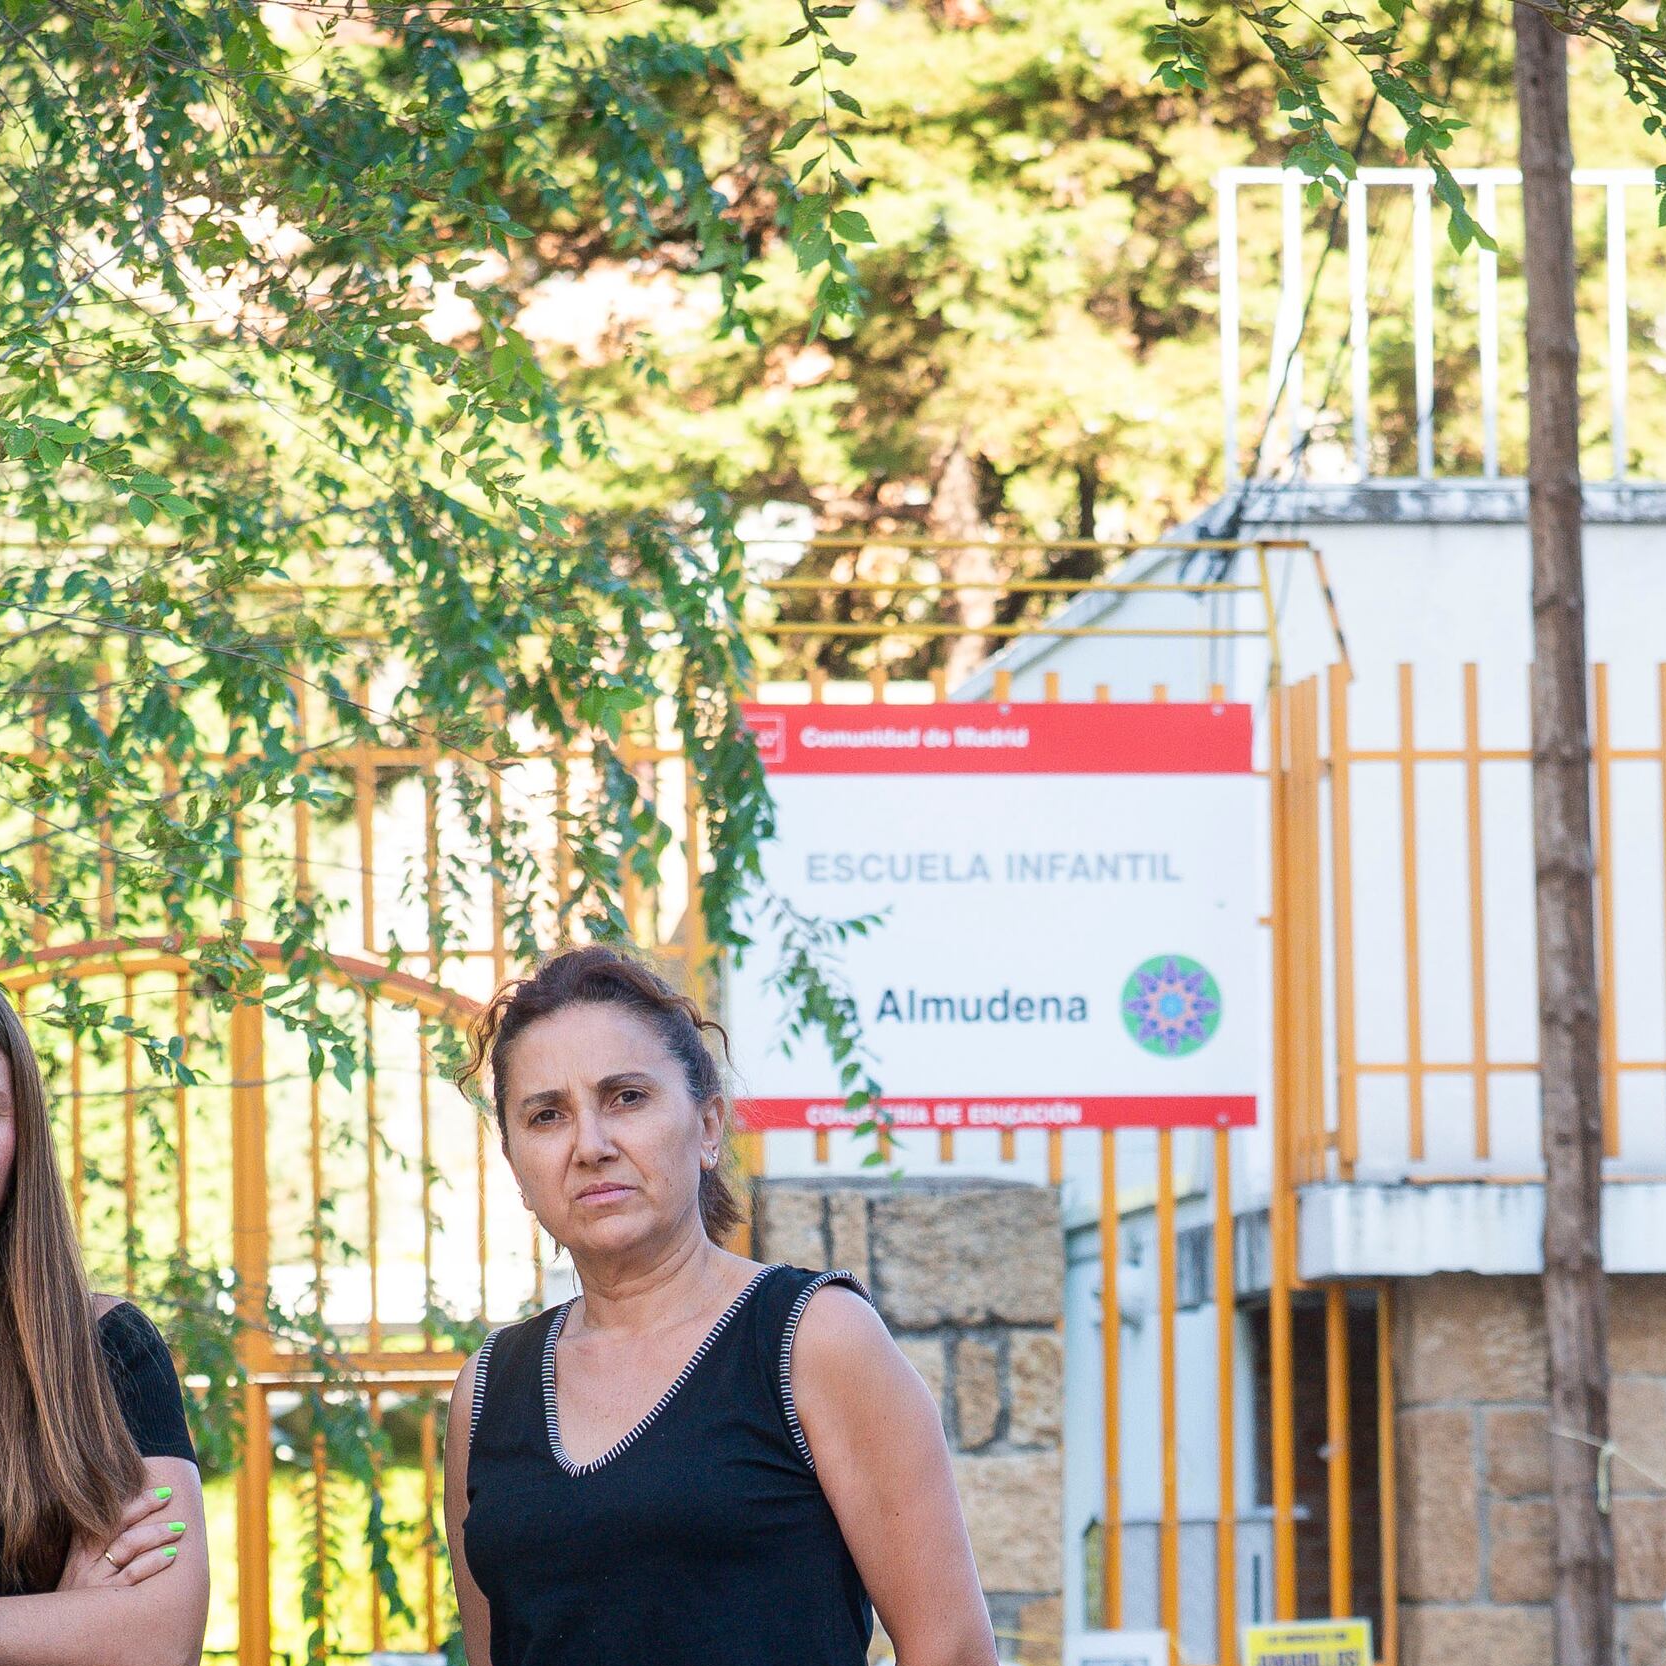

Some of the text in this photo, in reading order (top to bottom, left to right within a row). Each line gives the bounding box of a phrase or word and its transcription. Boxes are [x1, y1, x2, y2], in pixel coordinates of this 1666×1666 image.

[800, 726, 1030, 749] Comunidad de Madrid
[806, 853, 1182, 883] ESCUELA INFANTIL
[876, 988, 1089, 1024] Almudena
[935, 1103, 963, 1126] DE
[967, 1100, 1083, 1126] EDUCACIÓN
